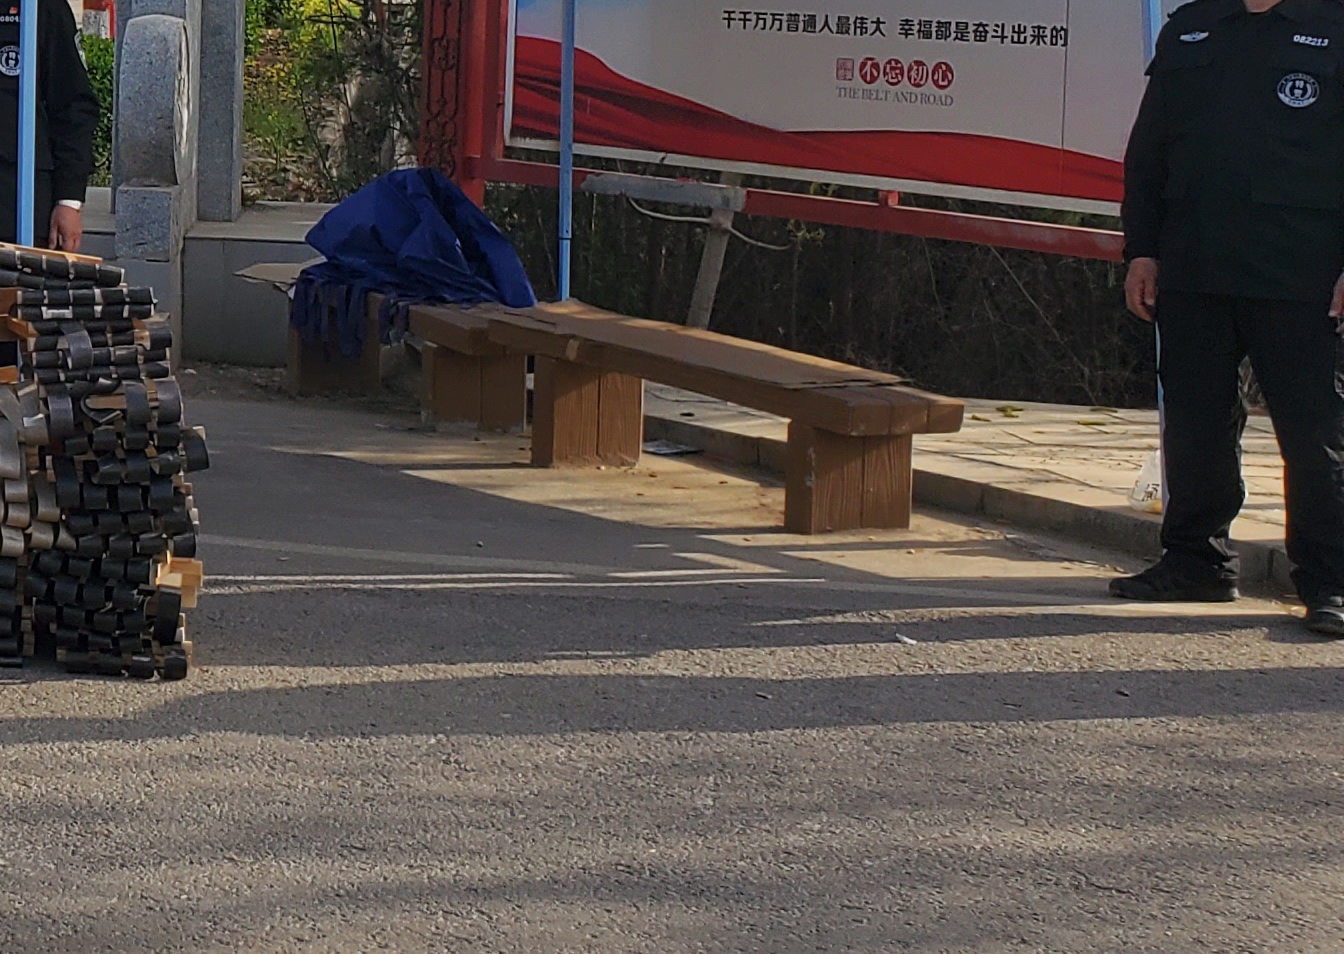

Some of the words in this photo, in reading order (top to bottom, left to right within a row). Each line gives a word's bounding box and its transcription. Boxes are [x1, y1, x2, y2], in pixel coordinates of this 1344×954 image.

[722, 9, 887, 38] 千千万万普通人最伟大
[898, 18, 1069, 47] 幸福都是奋斗出来的
[860, 58, 954, 89] 不忘初心
[836, 87, 861, 99] THE
[862, 89, 890, 102] BELT
[892, 92, 918, 105] AND
[920, 93, 954, 107] ROAD
